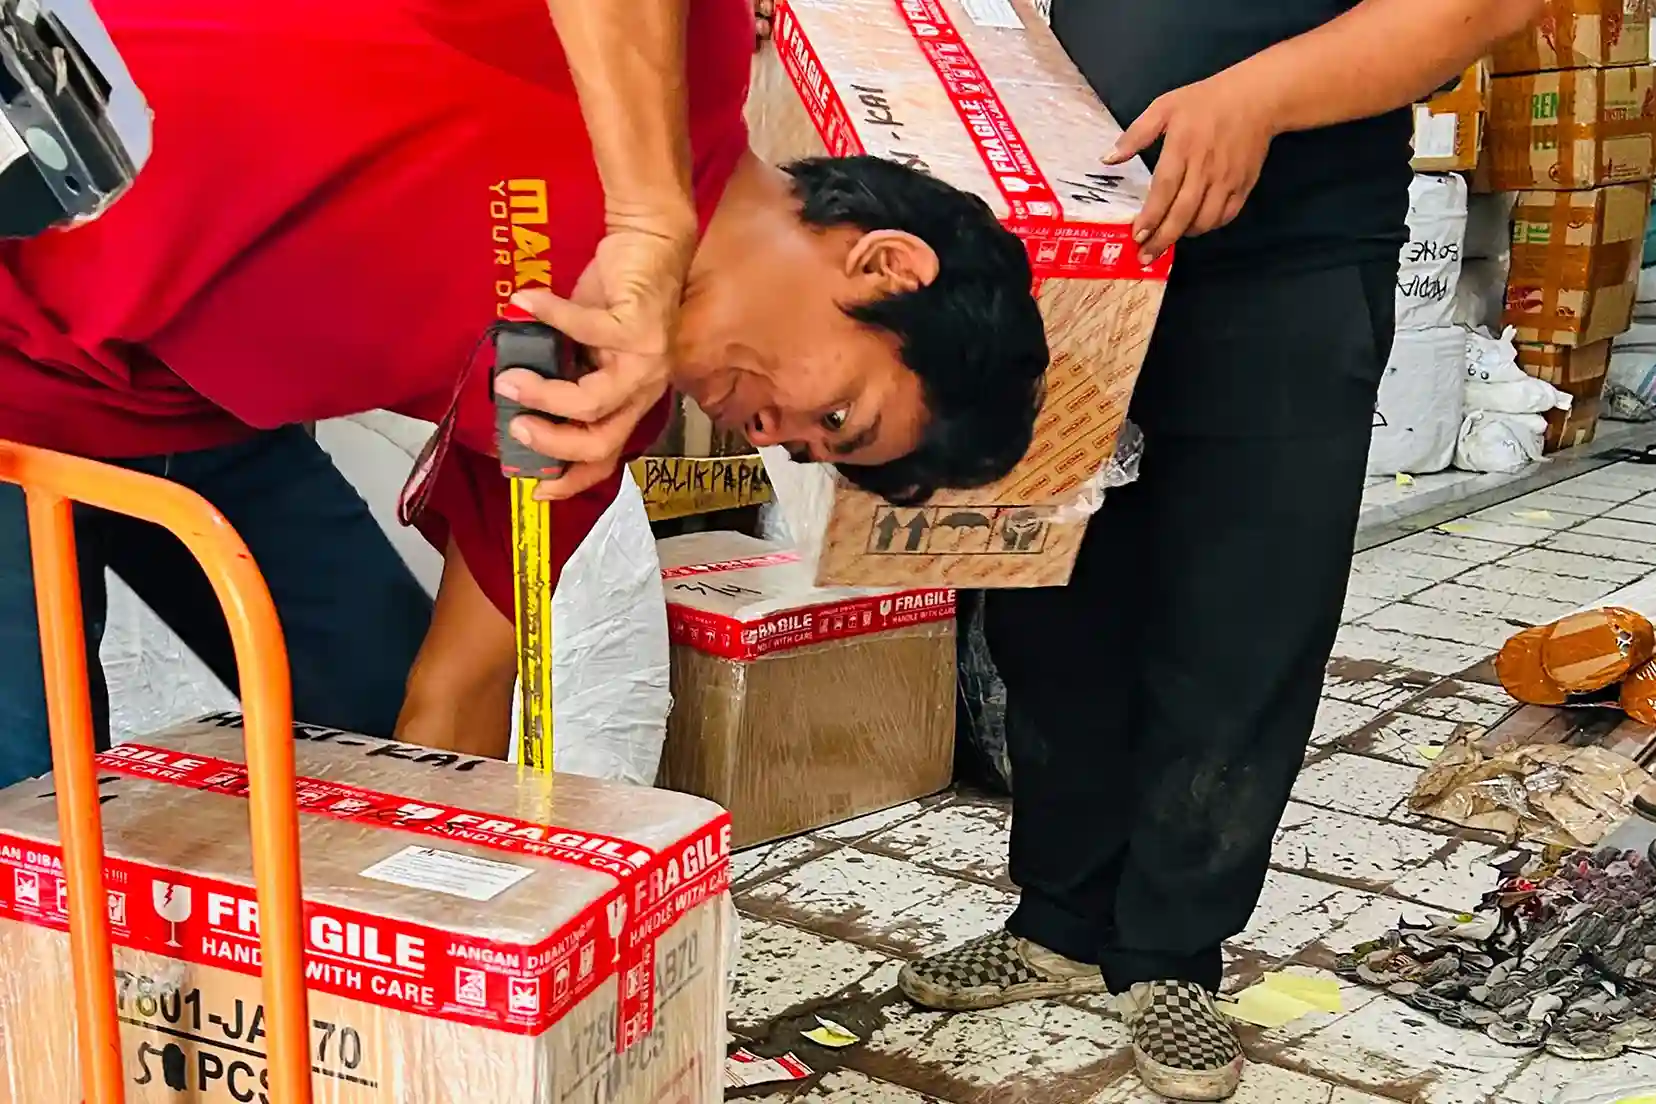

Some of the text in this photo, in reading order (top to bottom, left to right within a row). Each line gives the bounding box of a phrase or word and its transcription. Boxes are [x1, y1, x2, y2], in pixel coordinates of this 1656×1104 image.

[790, 27, 830, 109] FRAGILE
[958, 99, 1021, 173] FRAGILE
[489, 180, 512, 266] YOUR
[895, 590, 957, 612] FRAGILE
[774, 635, 792, 649] WITH
[794, 632, 813, 643] CARE
[130, 764, 188, 780] CARE
[423, 824, 517, 847] HANDLE
[523, 841, 584, 860] WITH
[634, 823, 732, 915] FRAGILE
[629, 901, 674, 949] HANDLE
[675, 881, 706, 912] WITH
[446, 943, 520, 968] JANGAN
[370, 975, 434, 1006] CARE
